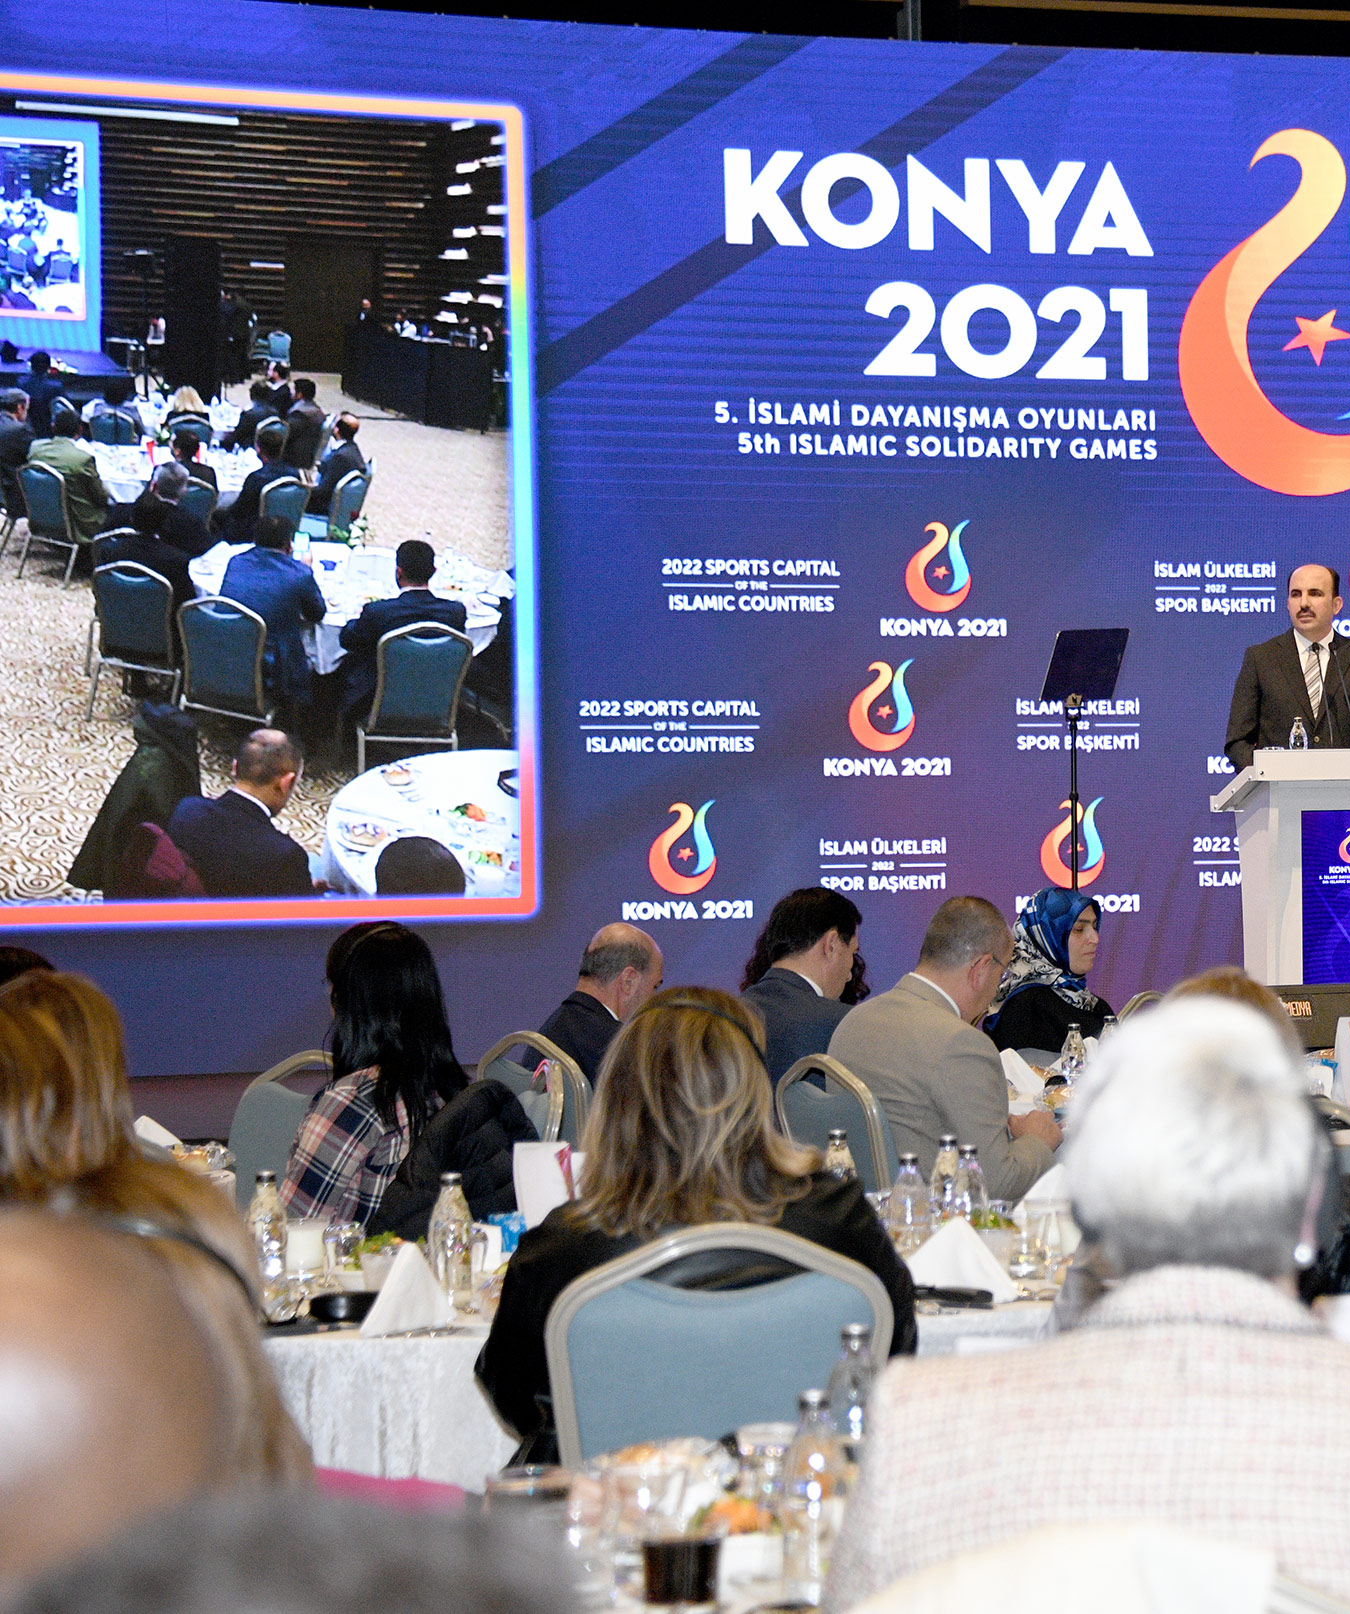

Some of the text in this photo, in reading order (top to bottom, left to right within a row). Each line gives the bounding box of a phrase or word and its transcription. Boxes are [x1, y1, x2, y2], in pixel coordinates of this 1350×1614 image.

[724, 148, 1154, 256] KONYA
[863, 281, 1148, 381] 2021
[714, 397, 1156, 433] 5. İSLAMİ DAYANIŞMA OYUNLARI
[738, 432, 1158, 460] 5th ISLAMIC SOLIDARITY GAMES
[661, 558, 841, 577] 2022 SPORTS CAPITAL
[1154, 560, 1276, 578] İSLAM ÜLKELERİ
[734, 580, 768, 591] OF THE
[1204, 583, 1227, 593] 2022
[668, 594, 835, 612] ISLAMIC COUNTRIES
[1155, 595, 1276, 616] SPOR BAŞKENTİ
[879, 618, 1008, 637] KONYA 2021
[579, 700, 761, 717] 2022 SPORTS CAPITAL
[1016, 697, 1140, 716] İSLAM LKELERİ
[653, 721, 687, 731] OF THE
[586, 736, 755, 753] ISLAMIC COUNTRIES
[1016, 735, 1060, 751] SPOR
[823, 757, 952, 777] KONYA 2021
[819, 836, 947, 856] İSLAM ÜLKELERİ
[1192, 836, 1231, 853] 2022
[871, 860, 895, 871] 2022
[820, 871, 946, 893] SPOR BAŞKENTİ
[1198, 870, 1242, 887] ISLAM
[623, 900, 754, 921] KONYA 2021
